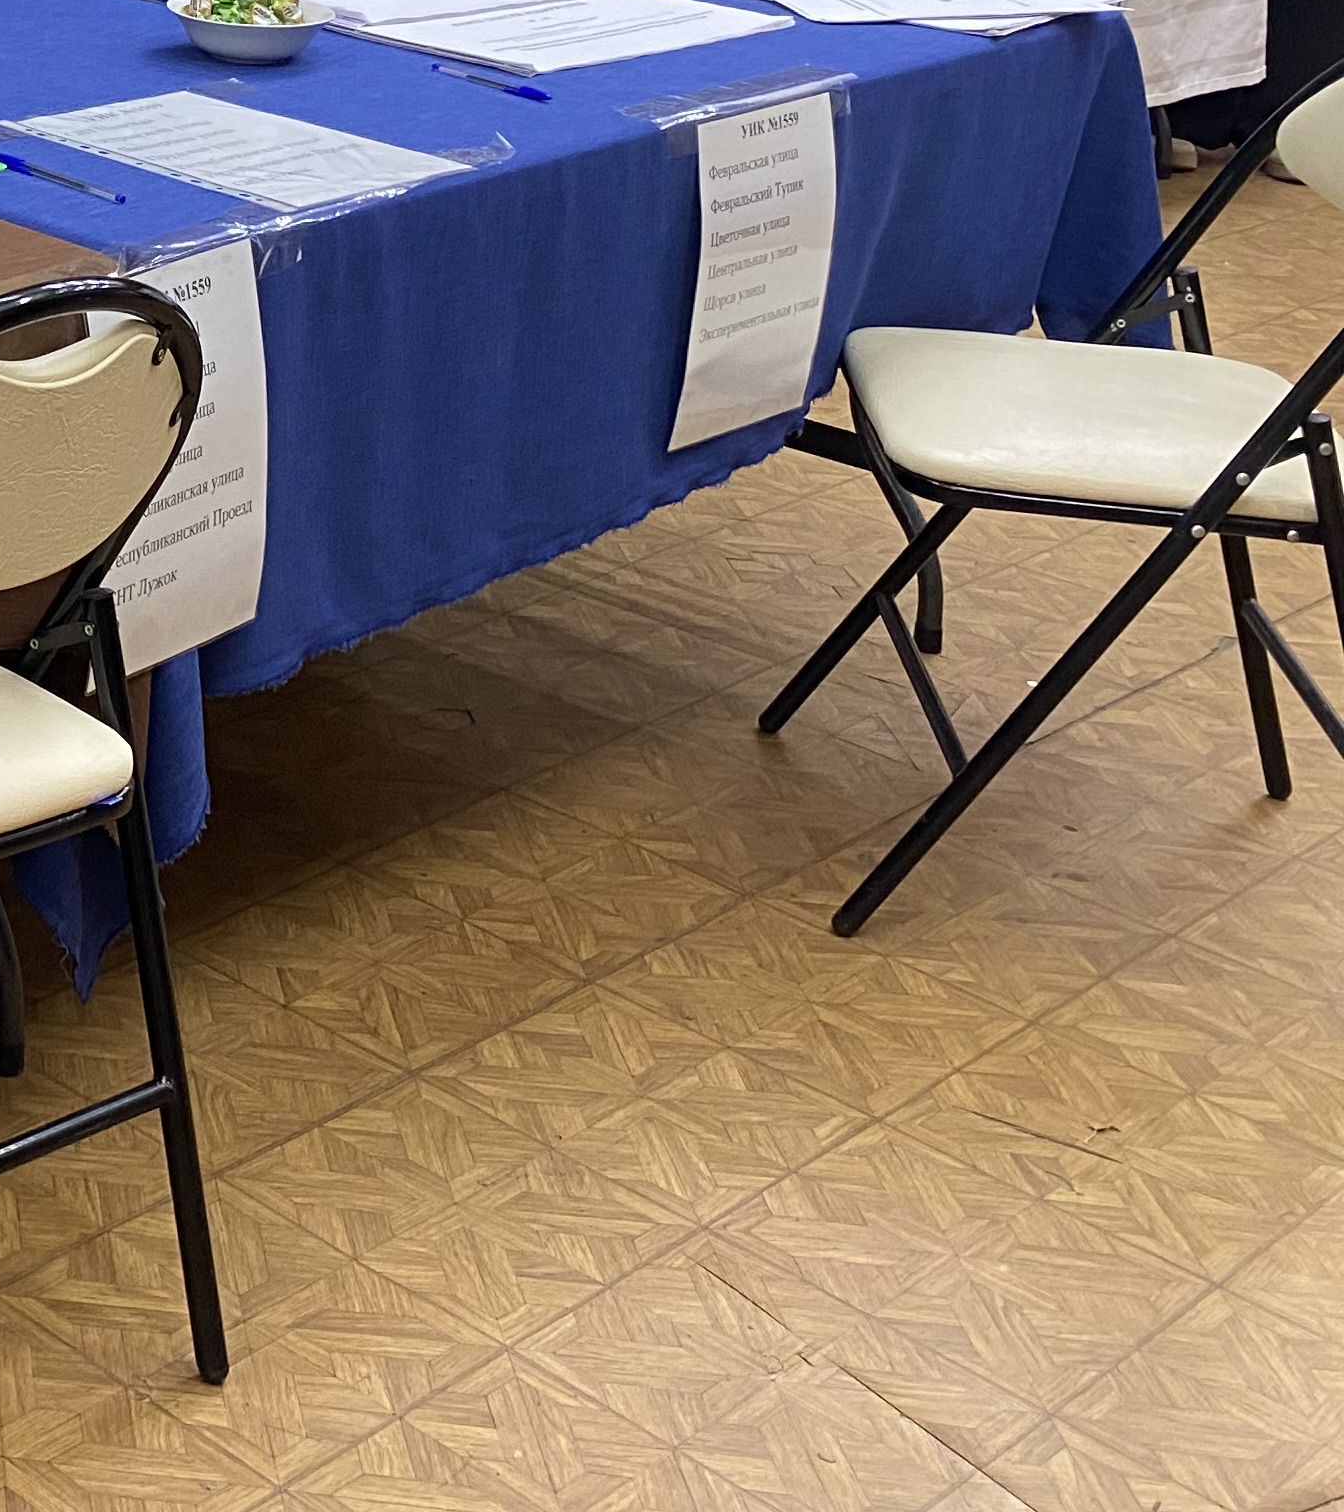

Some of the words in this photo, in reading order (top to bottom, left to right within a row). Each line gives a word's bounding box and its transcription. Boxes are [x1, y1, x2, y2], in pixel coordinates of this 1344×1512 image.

[741, 120, 765, 139] УИК
[767, 112, 799, 132] №1559
[709, 155, 769, 180] Февральская
[771, 148, 799, 168] улица
[710, 186, 773, 214] Февральский
[775, 180, 804, 199] Тупик
[711, 222, 760, 248] Цветочная
[762, 216, 790, 236] улица
[708, 253, 768, 280] Центральная
[770, 245, 798, 263] улица
[172, 276, 211, 303] №1559
[738, 284, 766, 303] улица
[699, 305, 791, 343] Экспериментальная
[793, 296, 820, 316] улица
[175, 445, 203, 467] лица
[211, 467, 244, 495] улица
[114, 515, 210, 569] еспубликанский
[213, 500, 253, 528] Проезд
[137, 570, 178, 598] Лужок
